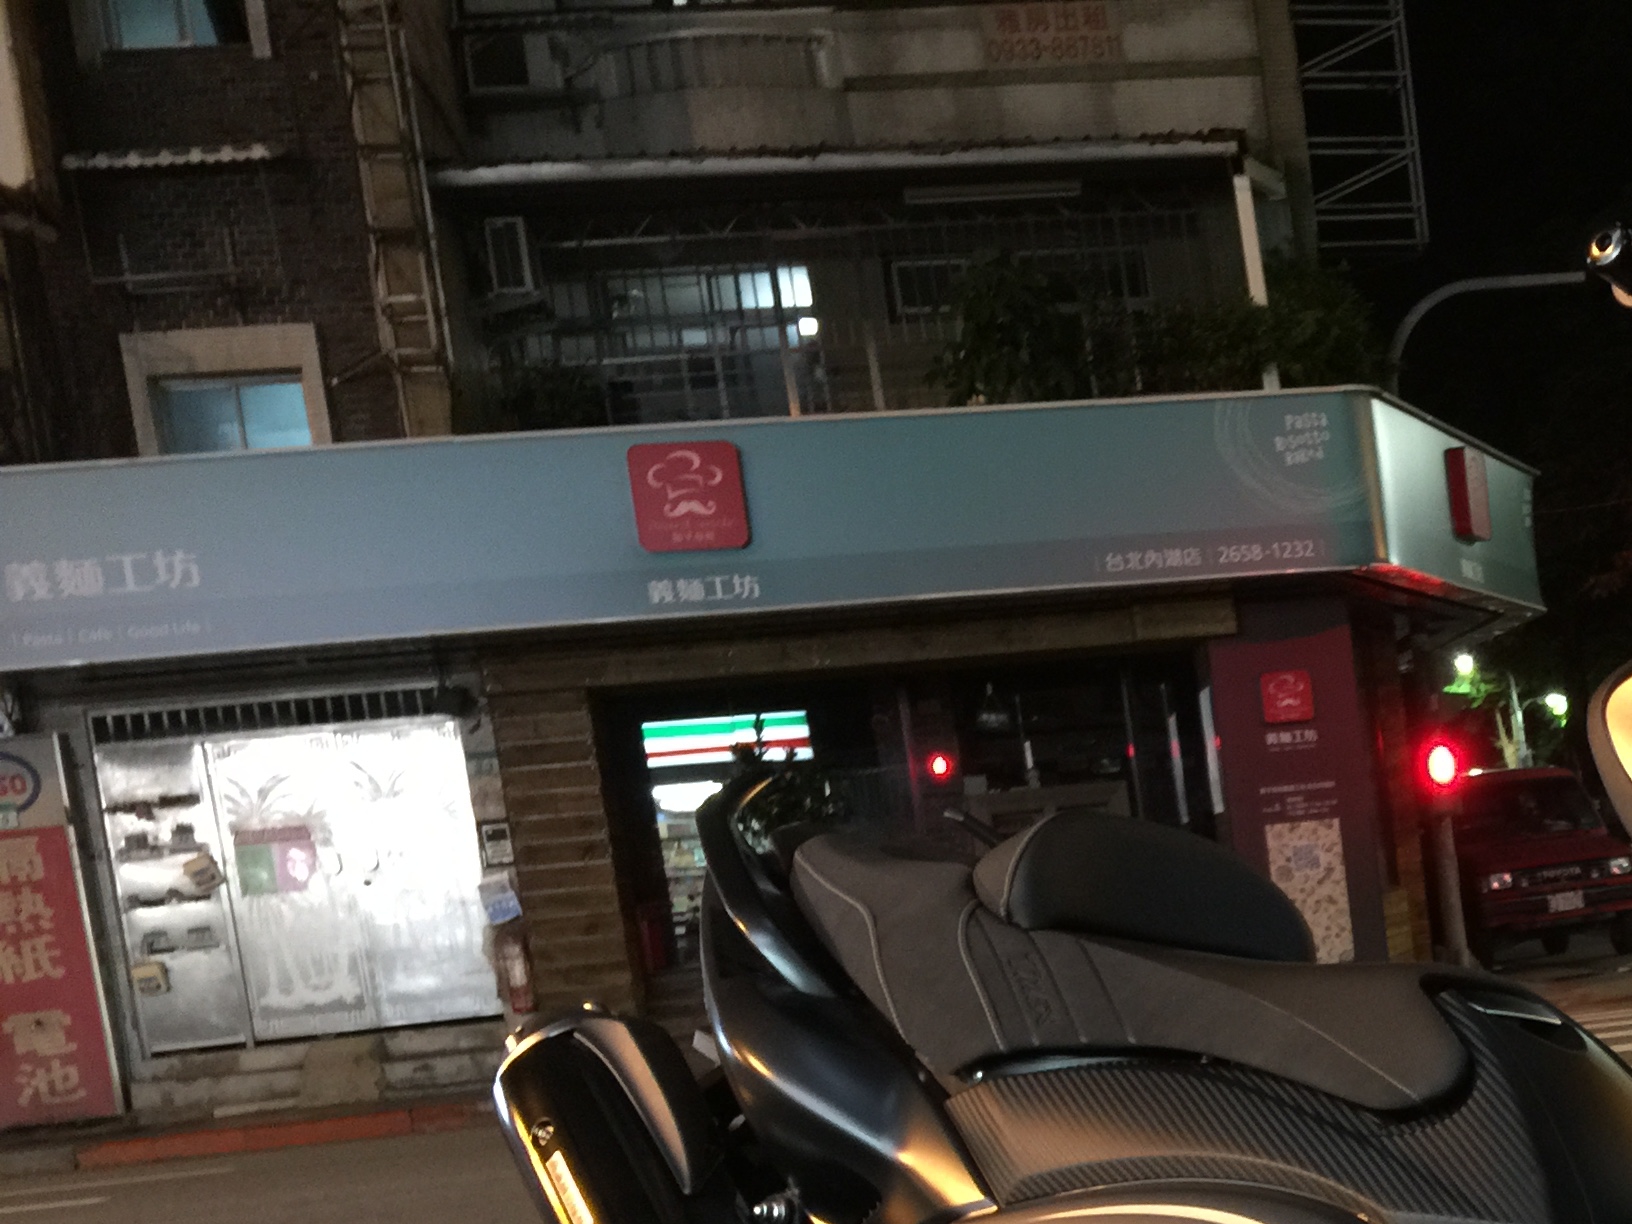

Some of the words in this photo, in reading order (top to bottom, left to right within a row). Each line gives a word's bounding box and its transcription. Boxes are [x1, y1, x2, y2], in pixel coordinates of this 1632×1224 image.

[1216, 538, 1316, 565] 2658-1232
[4, 548, 202, 603] 義麵工坊
[648, 573, 761, 604] 義麵工坊
